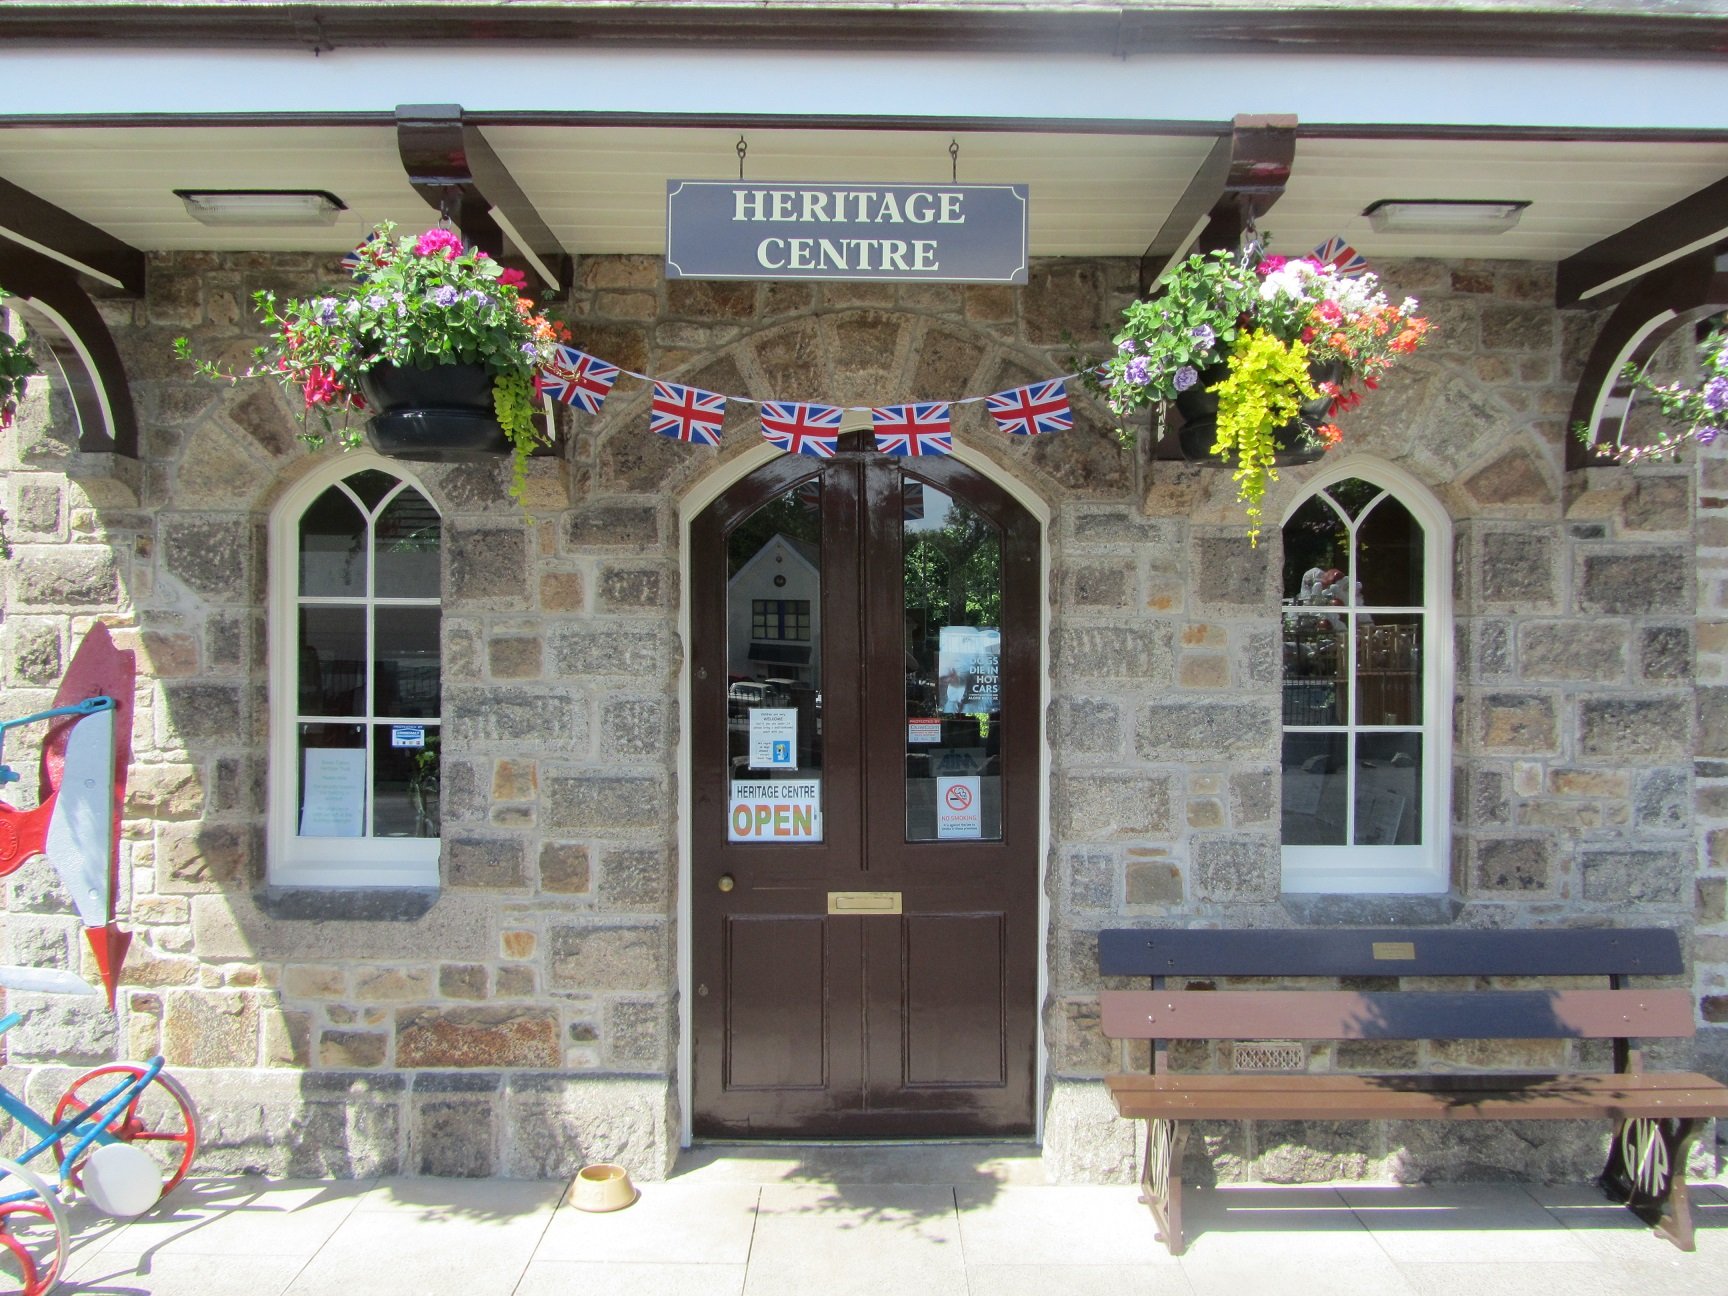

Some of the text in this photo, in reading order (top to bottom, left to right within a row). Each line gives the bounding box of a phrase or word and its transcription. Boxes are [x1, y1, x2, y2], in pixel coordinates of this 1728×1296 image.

[732, 190, 965, 224] HERITAGE
[756, 237, 939, 271] CENTRE
[969, 666, 999, 675] DIE IN
[976, 675, 999, 684] HOT
[972, 684, 998, 693] CARS
[736, 785, 815, 798] HERITAGE CENTRE
[733, 803, 812, 837] OPEN
[1622, 1117, 1668, 1197] GWR
